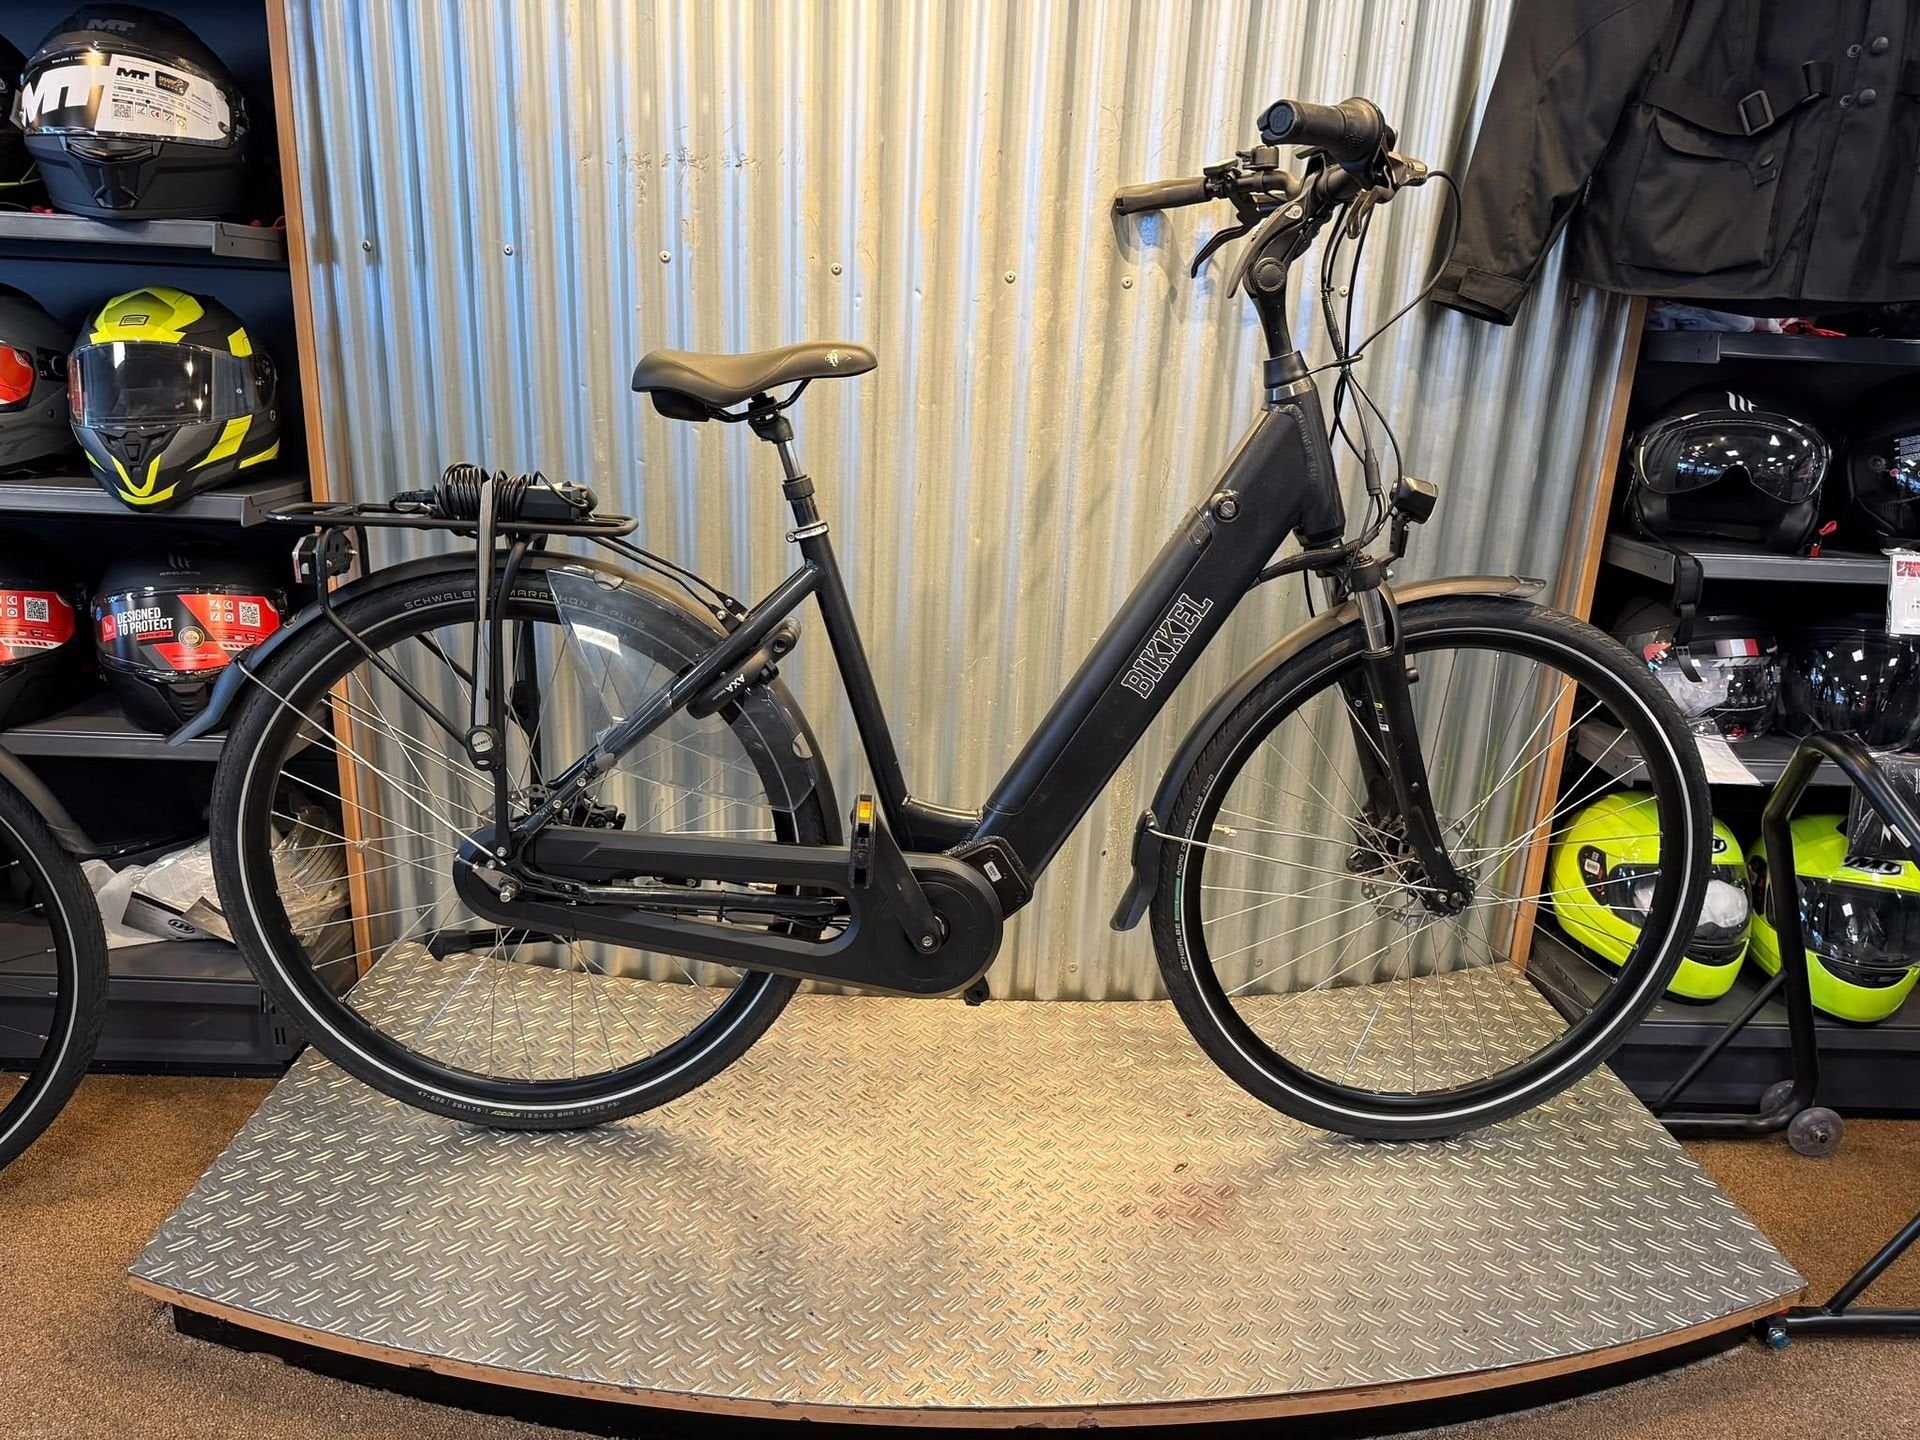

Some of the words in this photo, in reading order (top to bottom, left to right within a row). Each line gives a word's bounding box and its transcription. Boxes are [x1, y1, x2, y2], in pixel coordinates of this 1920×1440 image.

[86, 19, 135, 32] MT
[116, 67, 149, 80] MT
[117, 607, 161, 625] DESIGNED
[609, 610, 647, 629] PLUS
[118, 622, 129, 636] TO
[130, 617, 174, 634] PROTECT
[1120, 593, 1214, 700] BIKKEL
[725, 674, 745, 692] AXA
